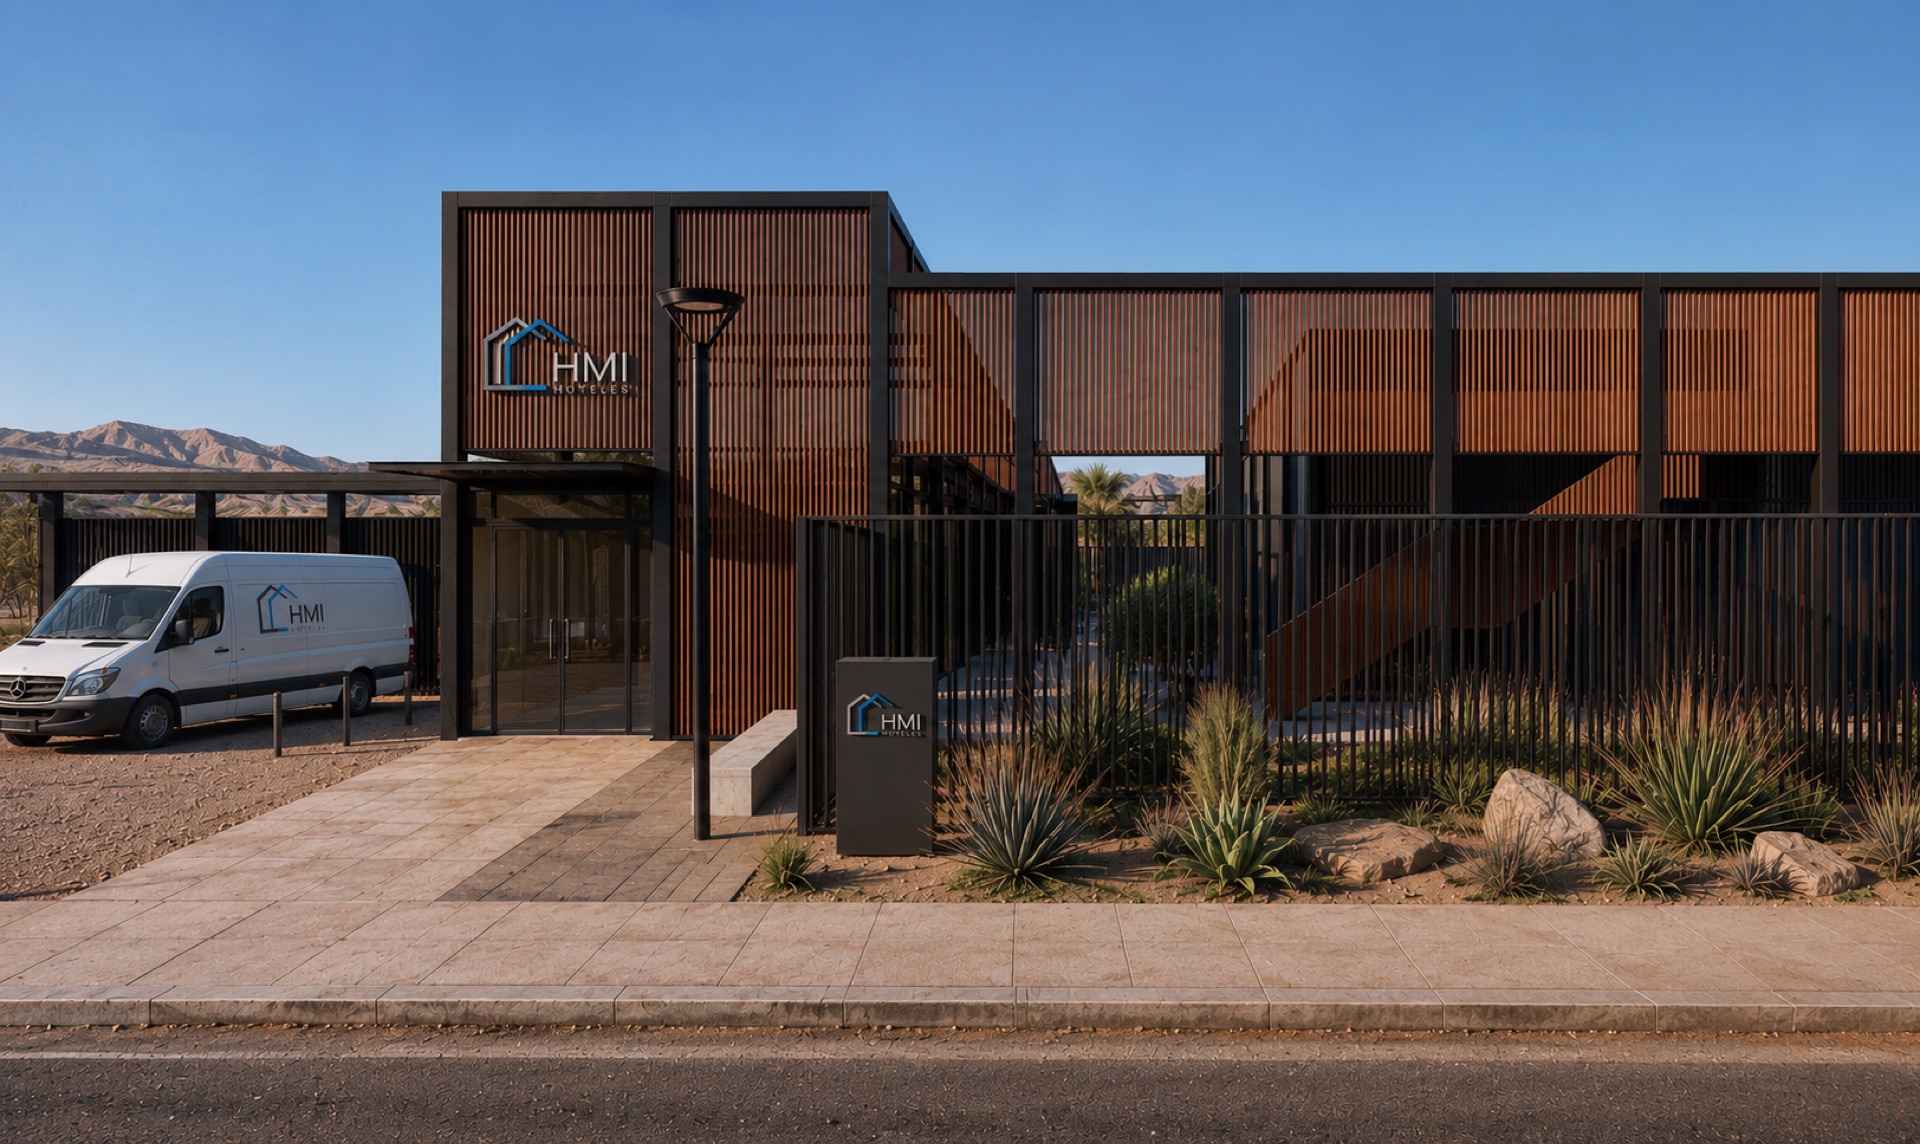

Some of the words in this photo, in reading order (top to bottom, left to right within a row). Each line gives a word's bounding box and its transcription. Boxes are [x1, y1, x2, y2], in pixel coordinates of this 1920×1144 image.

[553, 352, 627, 382] HMI
[554, 384, 629, 395] HOTELES
[289, 603, 324, 624] HMI
[881, 713, 921, 730] HMI
